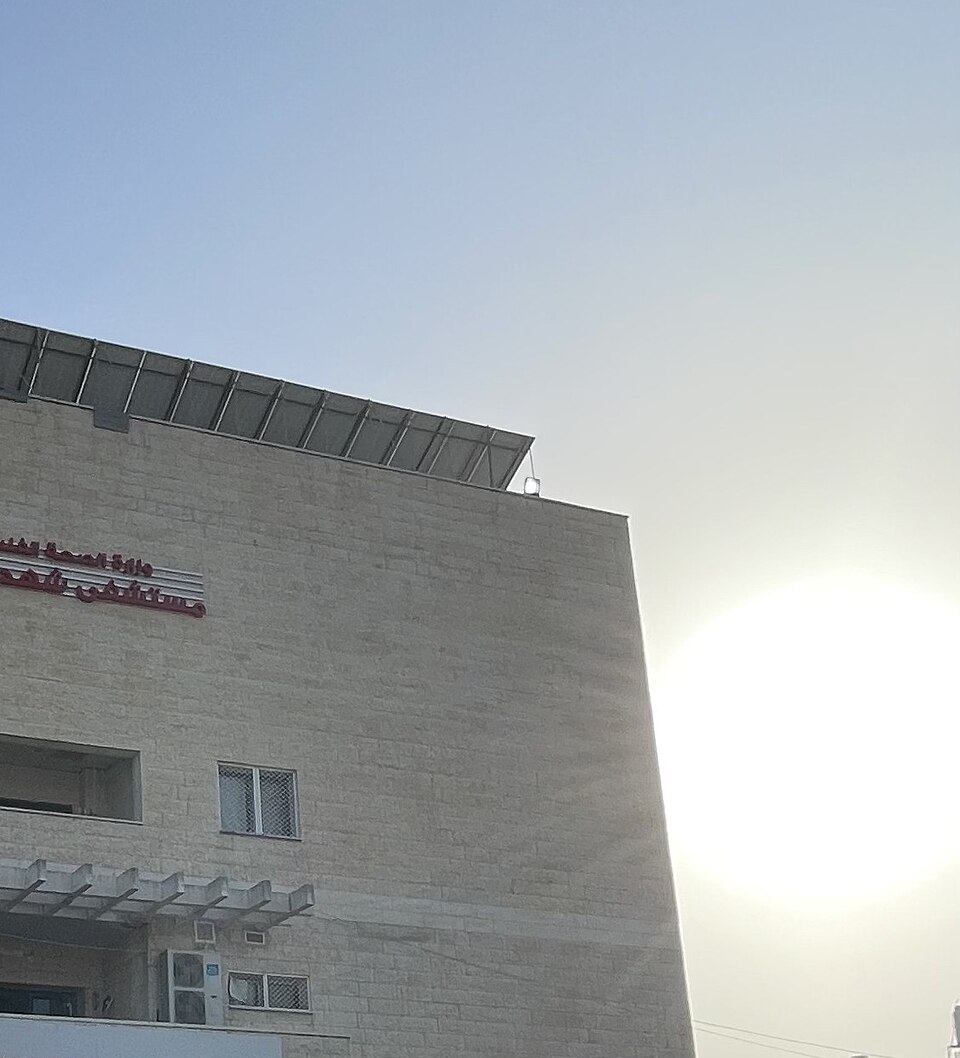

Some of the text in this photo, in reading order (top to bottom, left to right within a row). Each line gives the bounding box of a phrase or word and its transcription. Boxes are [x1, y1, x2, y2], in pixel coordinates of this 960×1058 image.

[44, 542, 107, 568] الصحة
[112, 554, 153, 577] وزارة
[75, 580, 206, 618] مستشفى
